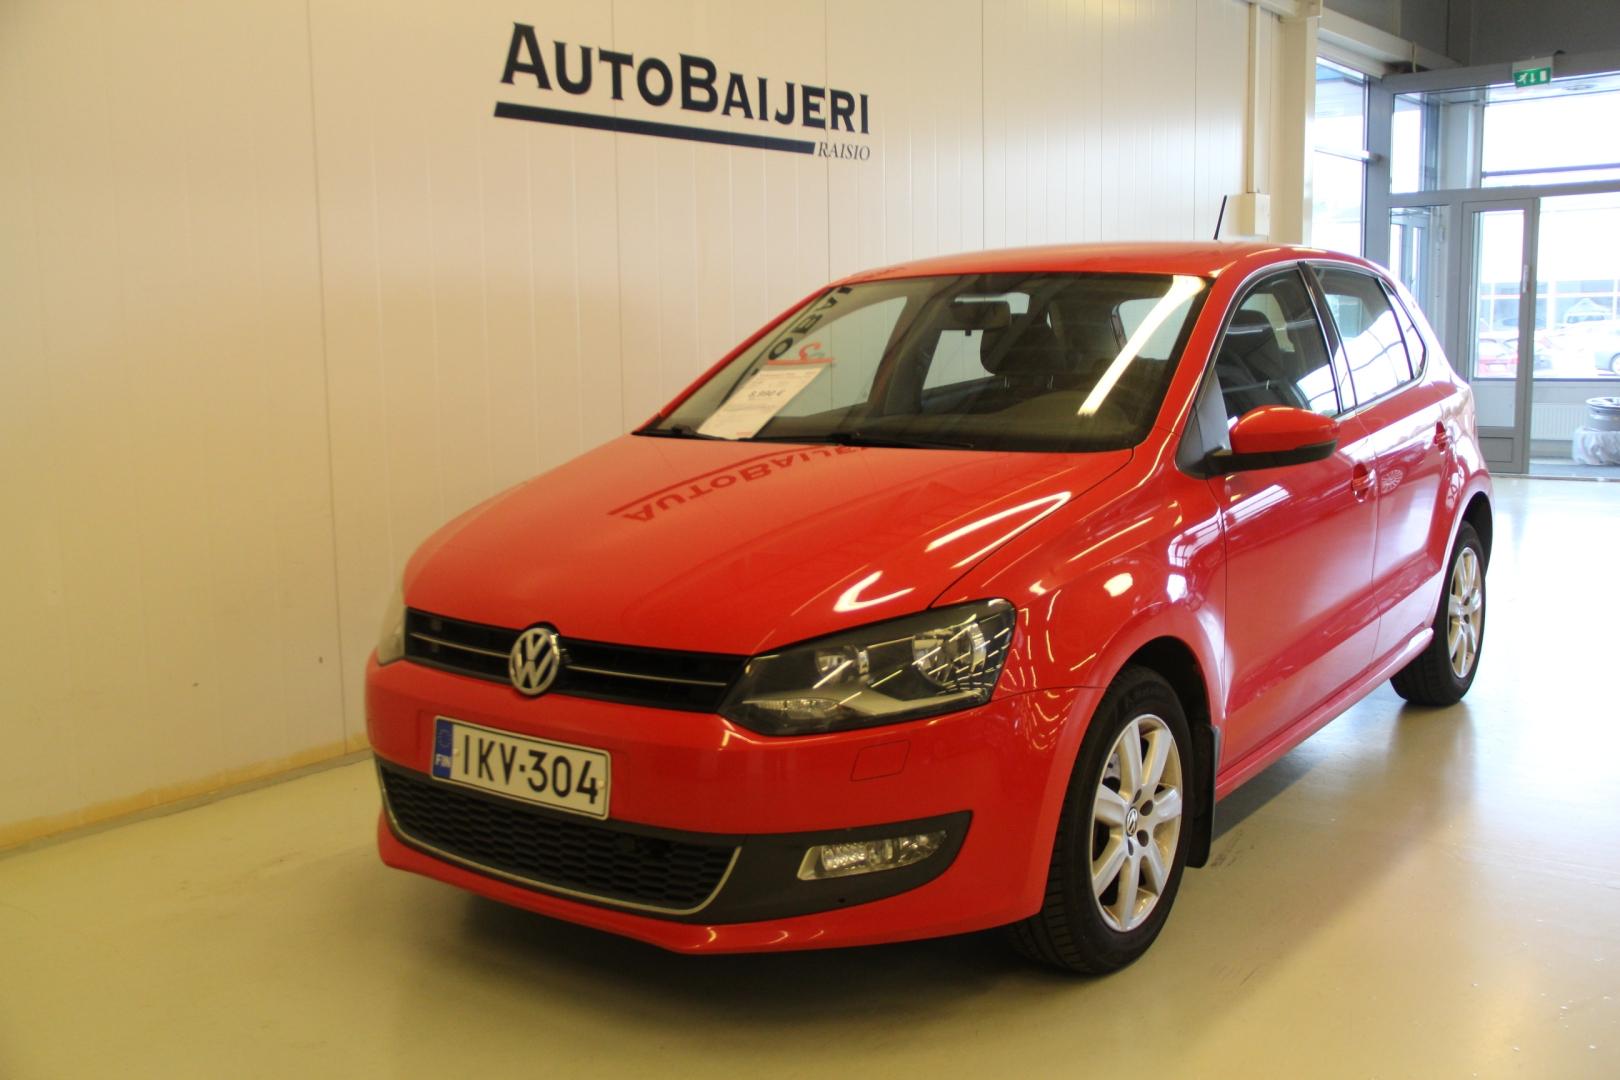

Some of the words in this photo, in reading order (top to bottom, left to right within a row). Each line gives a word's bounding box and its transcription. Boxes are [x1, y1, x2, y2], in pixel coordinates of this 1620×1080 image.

[500, 21, 870, 134] AUTOBAIJERI
[817, 141, 871, 161] RAISIO
[464, 735, 598, 804] IKV-304
